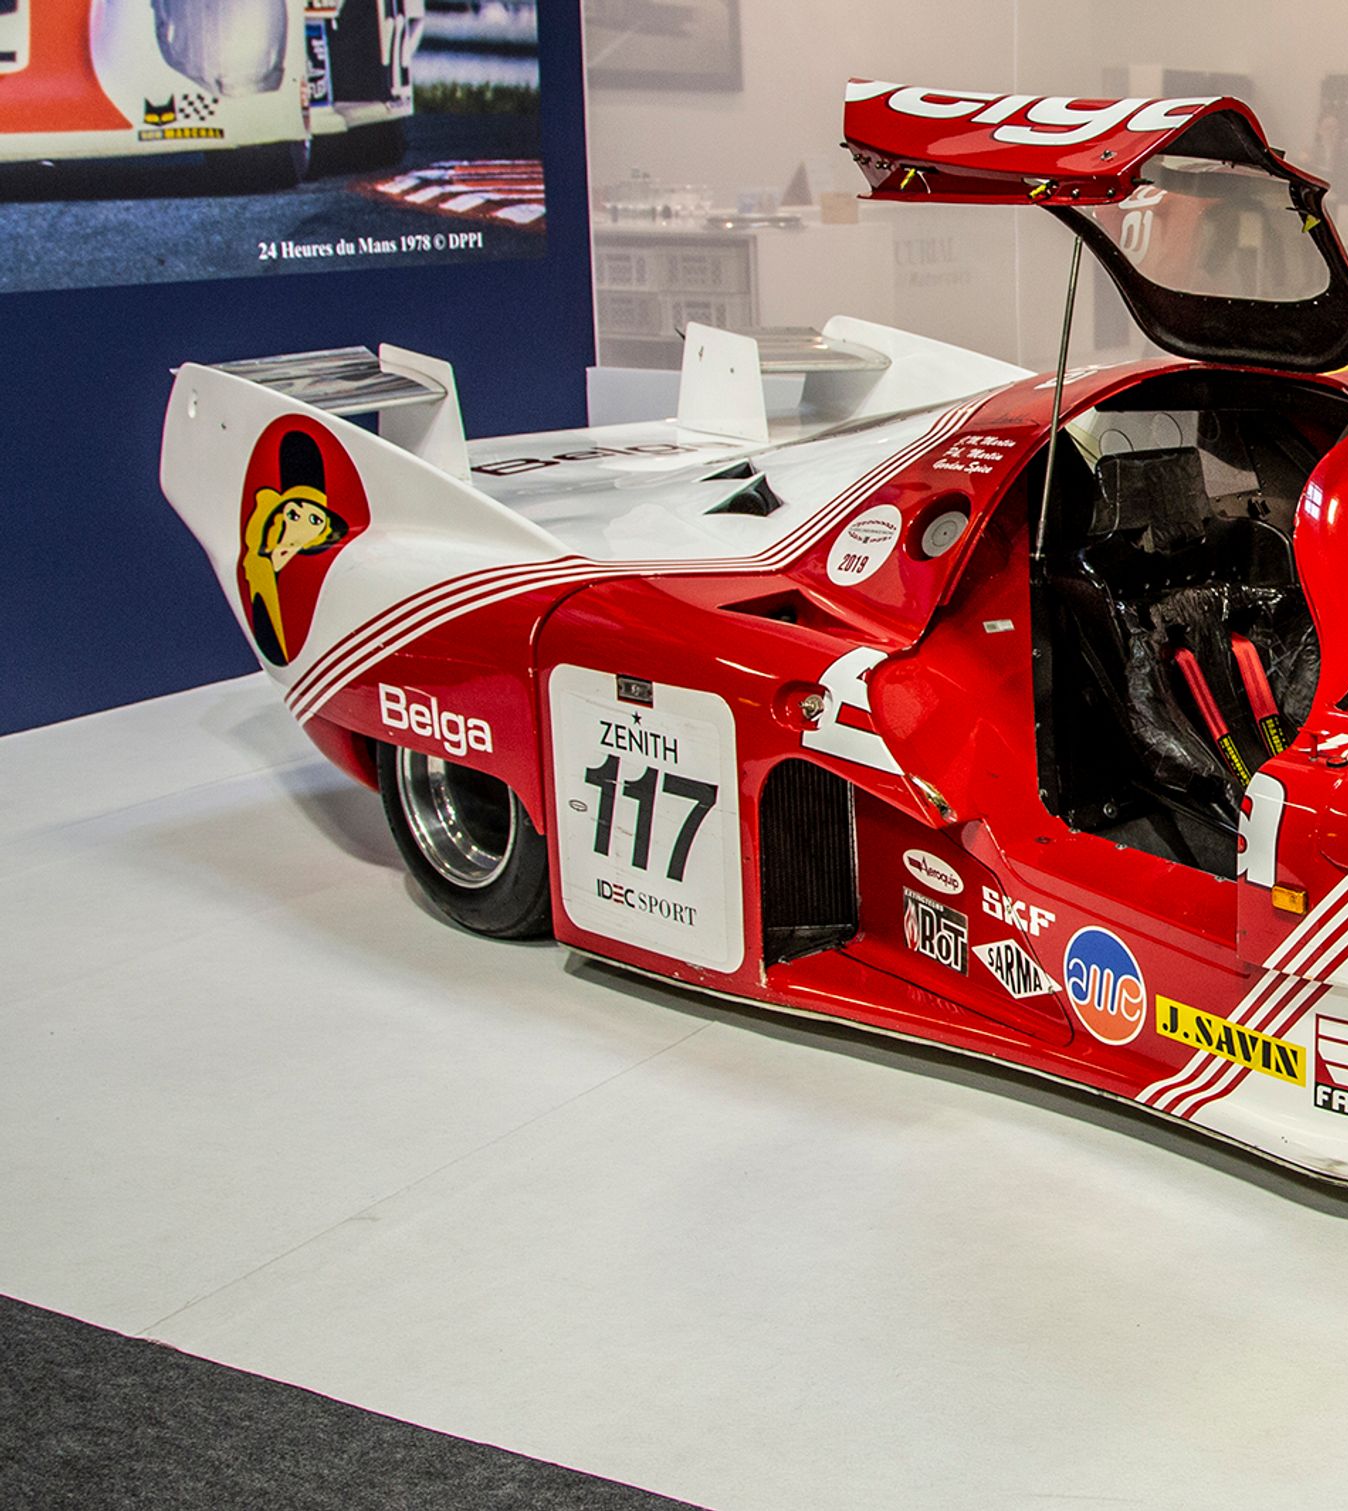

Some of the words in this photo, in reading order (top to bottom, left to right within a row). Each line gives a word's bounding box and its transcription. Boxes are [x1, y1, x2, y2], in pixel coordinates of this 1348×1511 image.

[258, 242, 277, 260] 24
[281, 240, 334, 259] Heures
[336, 239, 355, 255] du
[358, 237, 397, 254] Mans
[400, 234, 431, 251] 1978
[449, 232, 483, 249] DPPI
[932, 458, 965, 471] Gordon
[963, 461, 994, 475] Spice
[837, 553, 869, 574] 2019
[378, 682, 494, 757] Belga
[599, 720, 679, 765] ZENITH
[584, 753, 719, 883] 117
[921, 856, 960, 892] Aeroquip
[596, 878, 636, 909] IDEC
[637, 892, 698, 927] SPORT
[981, 885, 1057, 937] SKF
[987, 943, 1043, 996] SARMA
